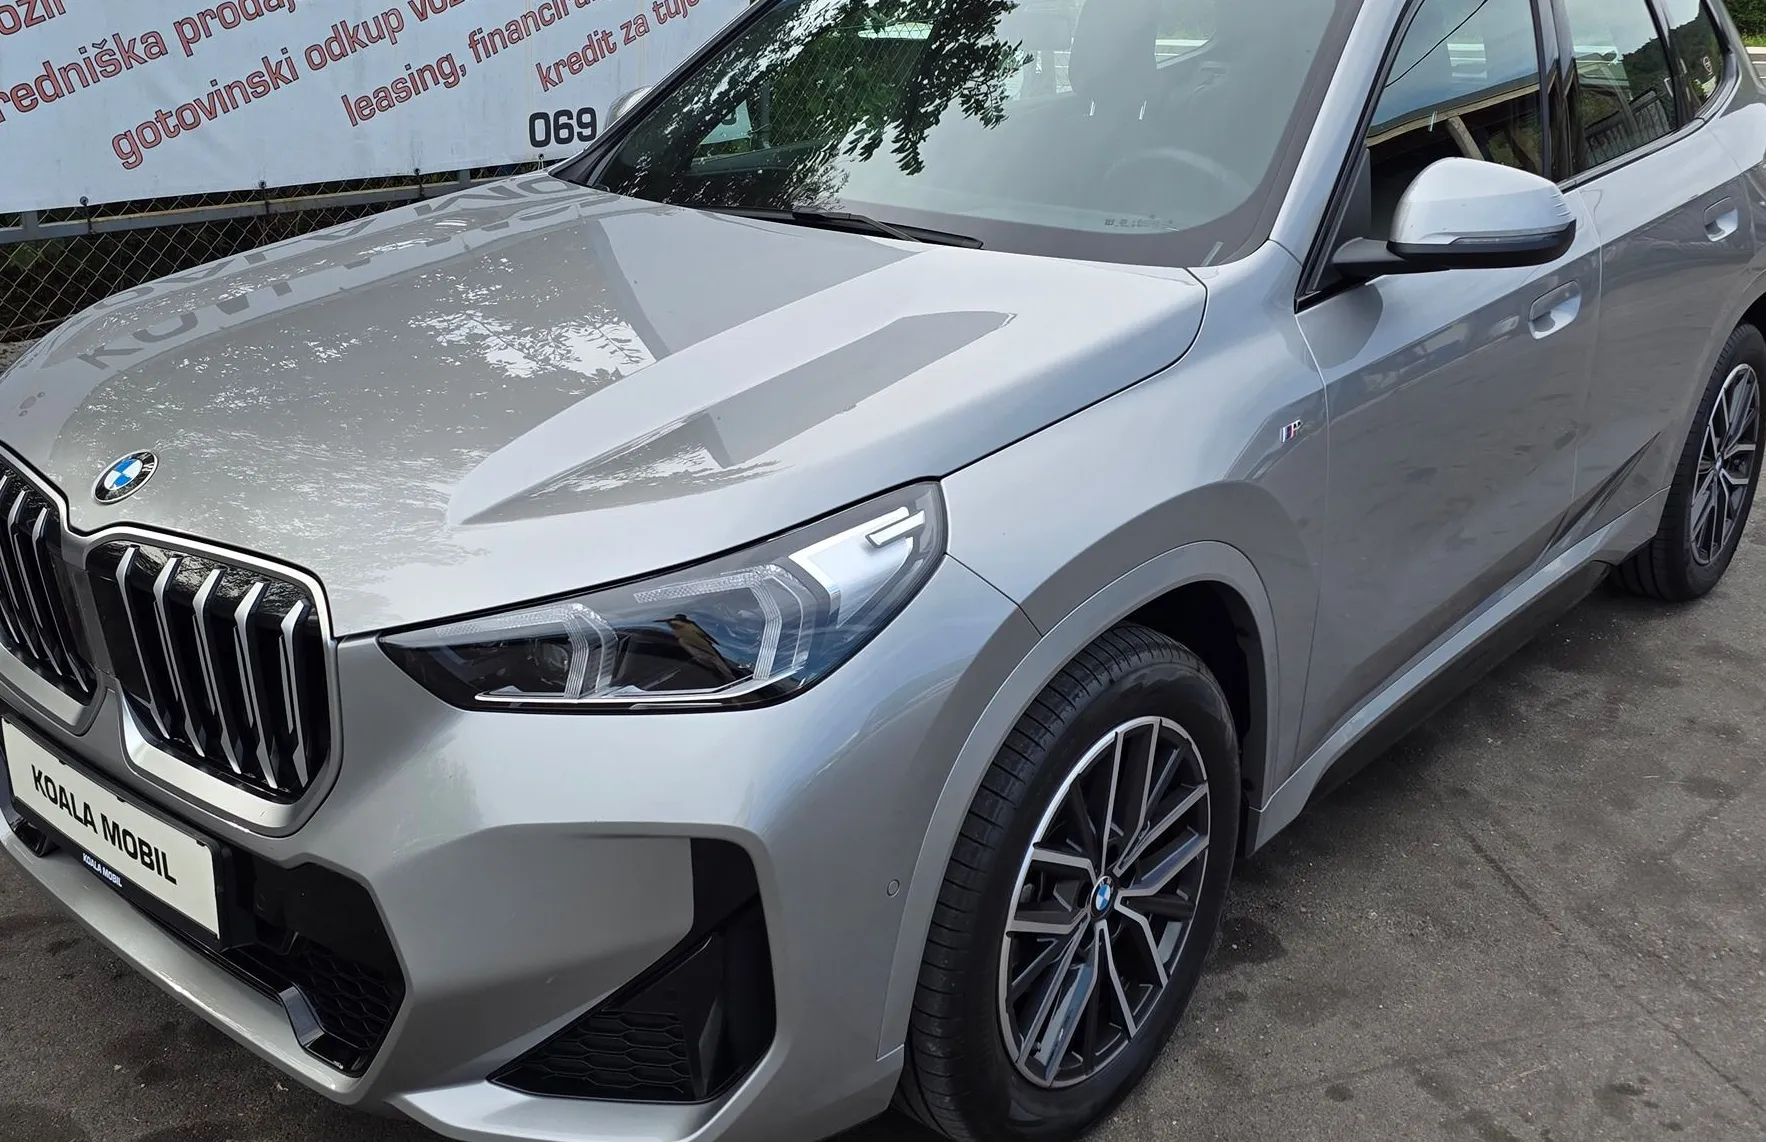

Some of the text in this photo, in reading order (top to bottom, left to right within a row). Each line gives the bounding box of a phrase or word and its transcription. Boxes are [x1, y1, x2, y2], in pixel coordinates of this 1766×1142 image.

[111, 0, 465, 170] gotovinski odkup vo
[340, 52, 467, 127] leasing,
[535, 29, 618, 92] kredit
[619, 13, 650, 46] za
[528, 107, 597, 148] 069
[31, 763, 177, 886] KOALA MOBIL
[82, 852, 123, 887] KOALA MOBIL
